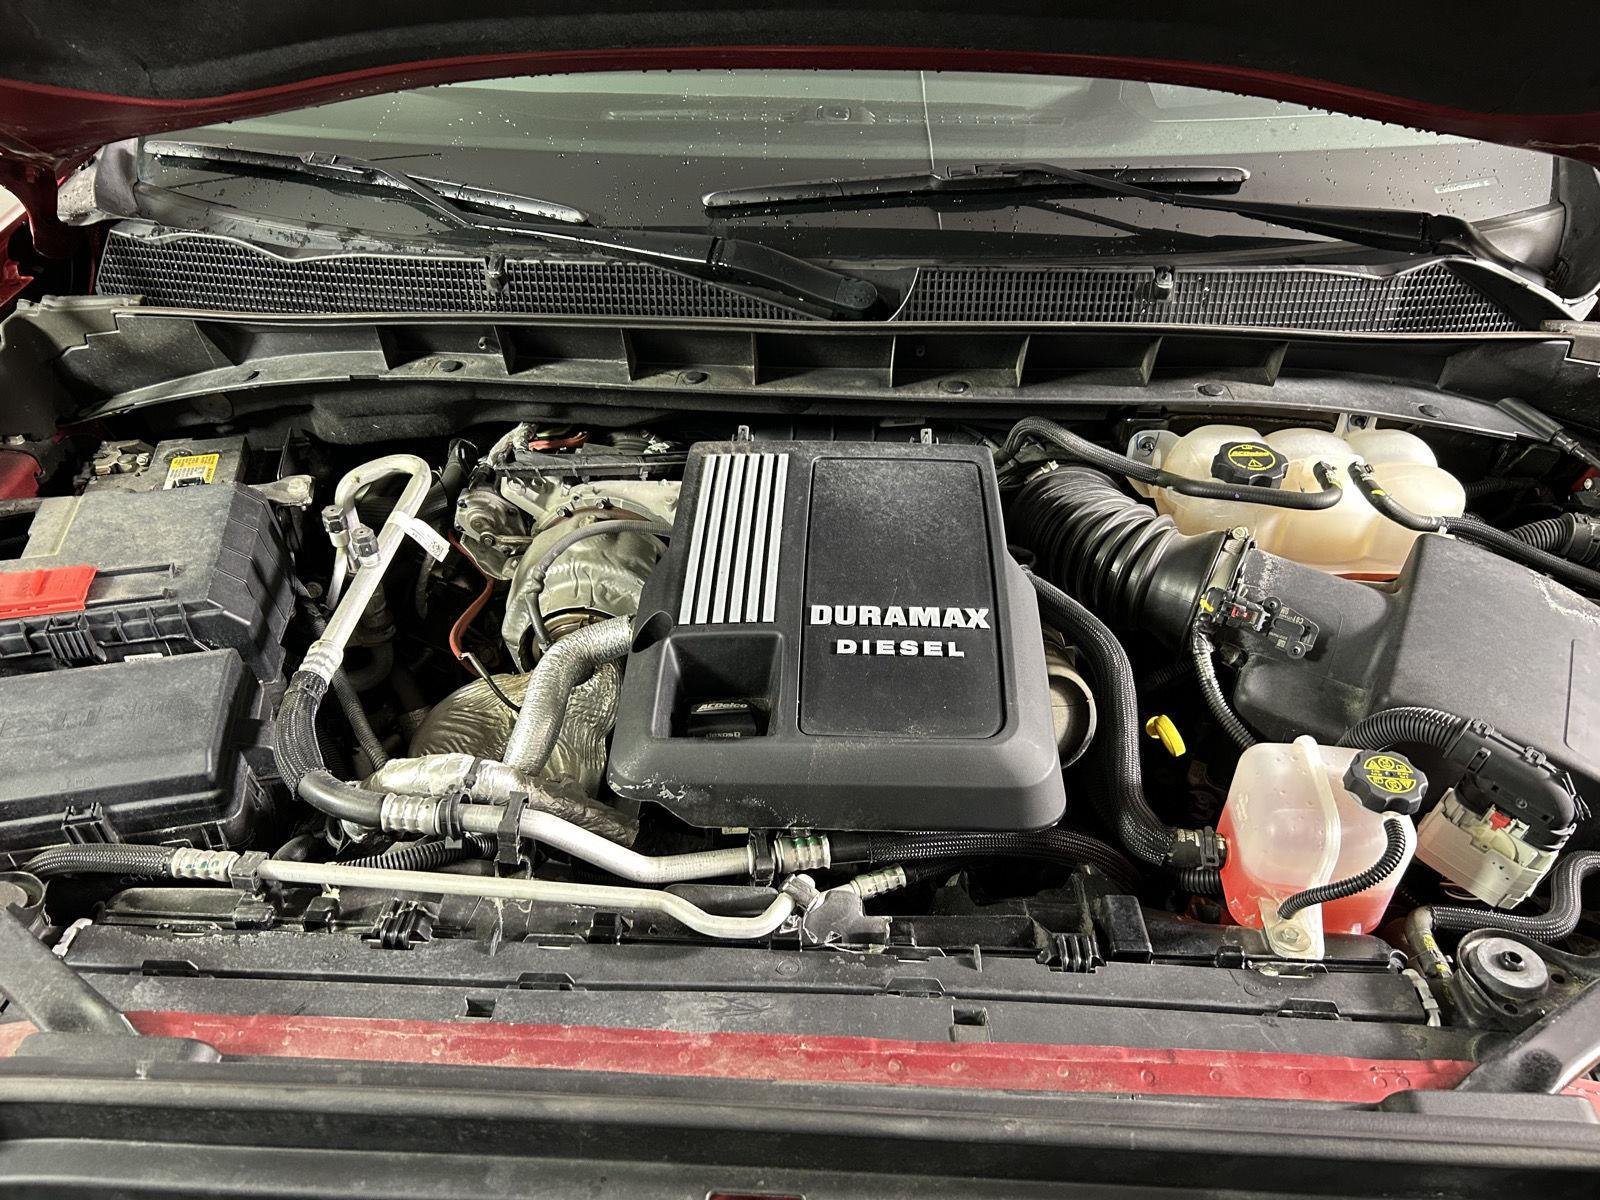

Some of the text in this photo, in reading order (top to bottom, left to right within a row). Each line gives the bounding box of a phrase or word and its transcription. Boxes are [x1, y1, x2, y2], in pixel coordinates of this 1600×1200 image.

[810, 605, 991, 629] DURAMAX
[836, 639, 965, 658] DIESEL
[697, 703, 748, 712] ACDelco
